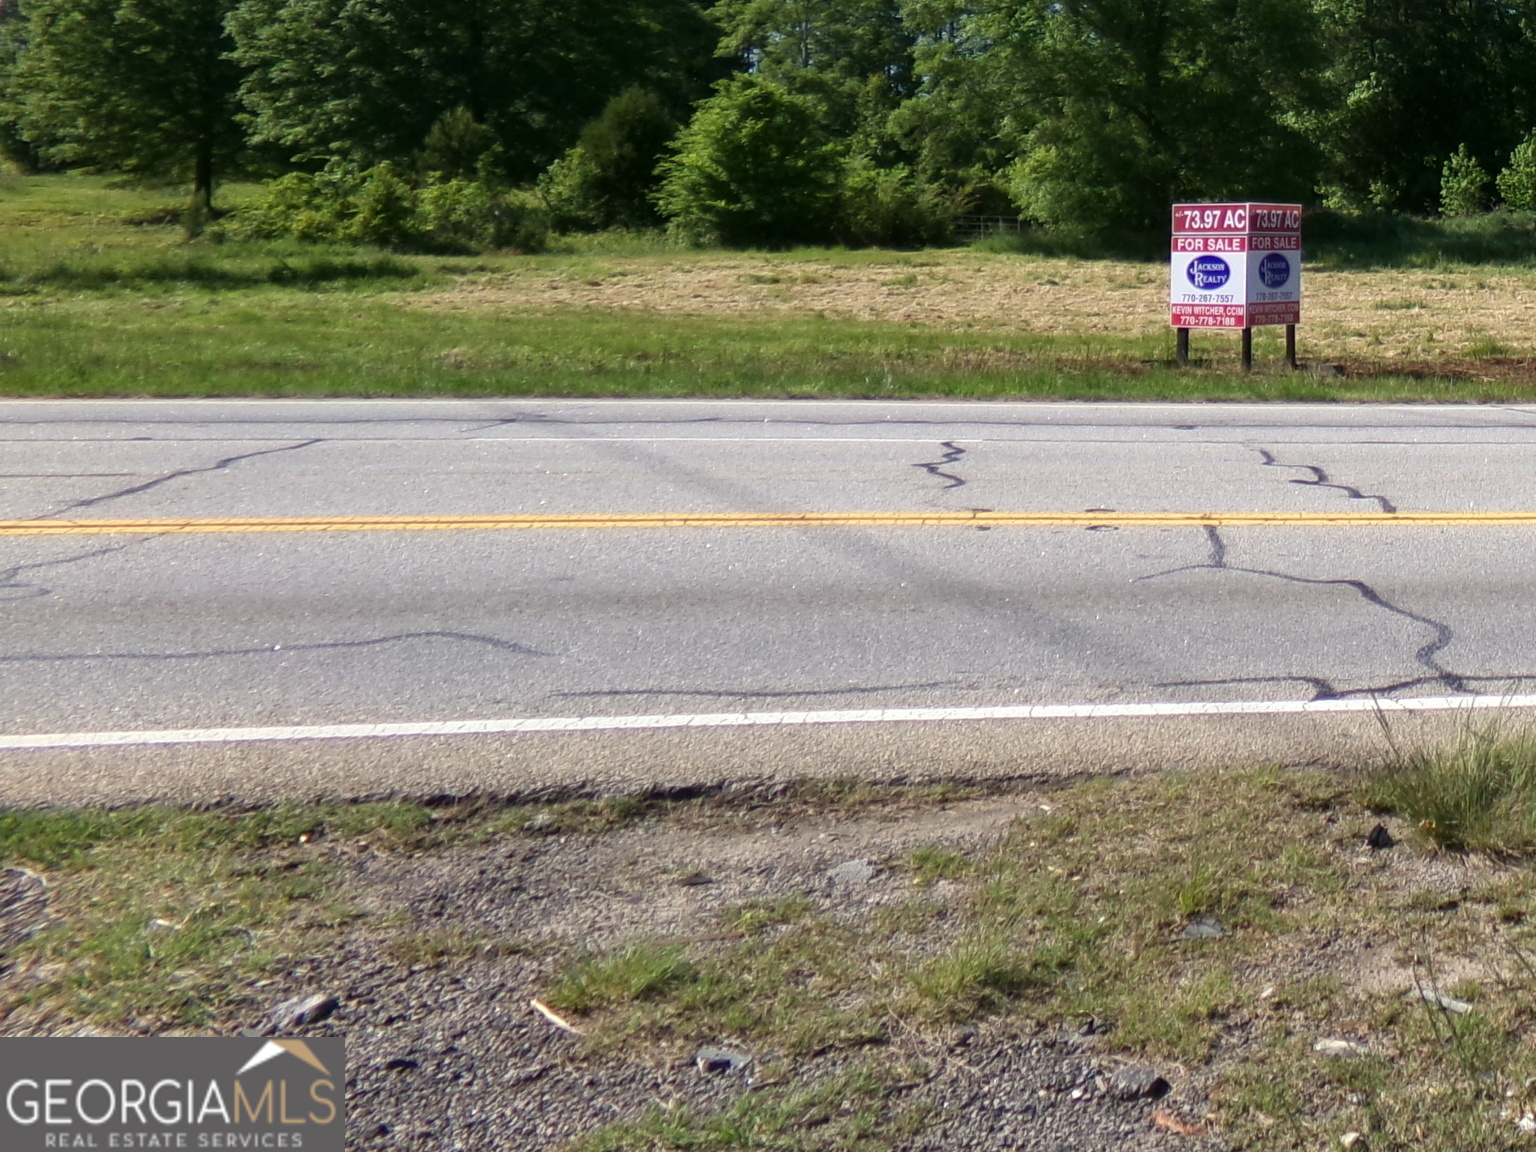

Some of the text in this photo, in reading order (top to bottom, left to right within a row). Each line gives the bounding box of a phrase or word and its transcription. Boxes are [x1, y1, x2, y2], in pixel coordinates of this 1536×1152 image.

[1223, 209, 1246, 229] AC
[1256, 209, 1283, 228] 73.97
[1284, 210, 1299, 228] AC
[1177, 238, 1240, 251] FOR SALE
[1252, 237, 1297, 249] FOR SALE
[1189, 260, 1225, 275] JACKSON
[1194, 272, 1227, 287] REALTY
[1181, 293, 1235, 303] 770-267-7557
[1172, 305, 1192, 315] KEVIN
[1180, 316, 1236, 326] 770-778-7188
